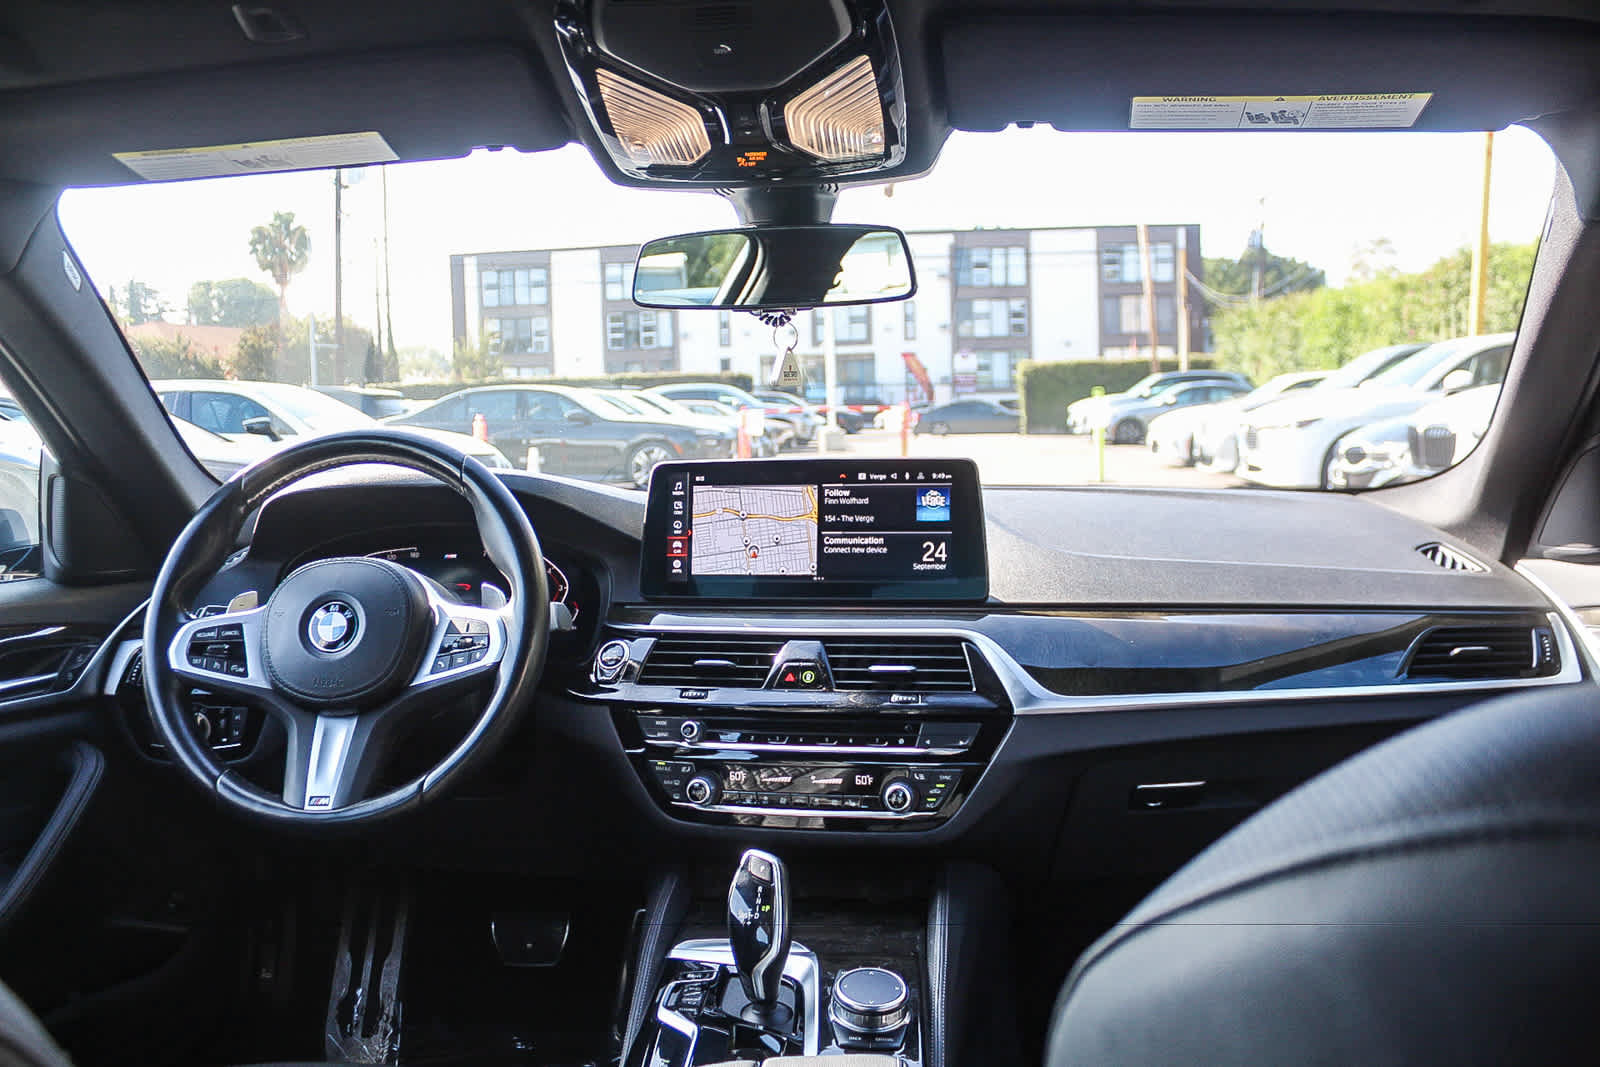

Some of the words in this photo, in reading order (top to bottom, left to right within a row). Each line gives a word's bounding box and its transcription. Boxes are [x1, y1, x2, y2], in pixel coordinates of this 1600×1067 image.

[1318, 93, 1415, 101] AVERTISSEMENT
[824, 488, 851, 497] Follow
[824, 497, 839, 505] Finn
[839, 497, 869, 505] Wolfhard
[921, 495, 946, 507] VERGE
[824, 514, 836, 522] 154
[841, 514, 855, 522] The
[855, 514, 875, 523] Verge
[823, 536, 884, 545] Communication
[823, 546, 851, 554] Connect
[866, 546, 888, 554] device
[922, 541, 948, 562] 24
[912, 562, 947, 571] September
